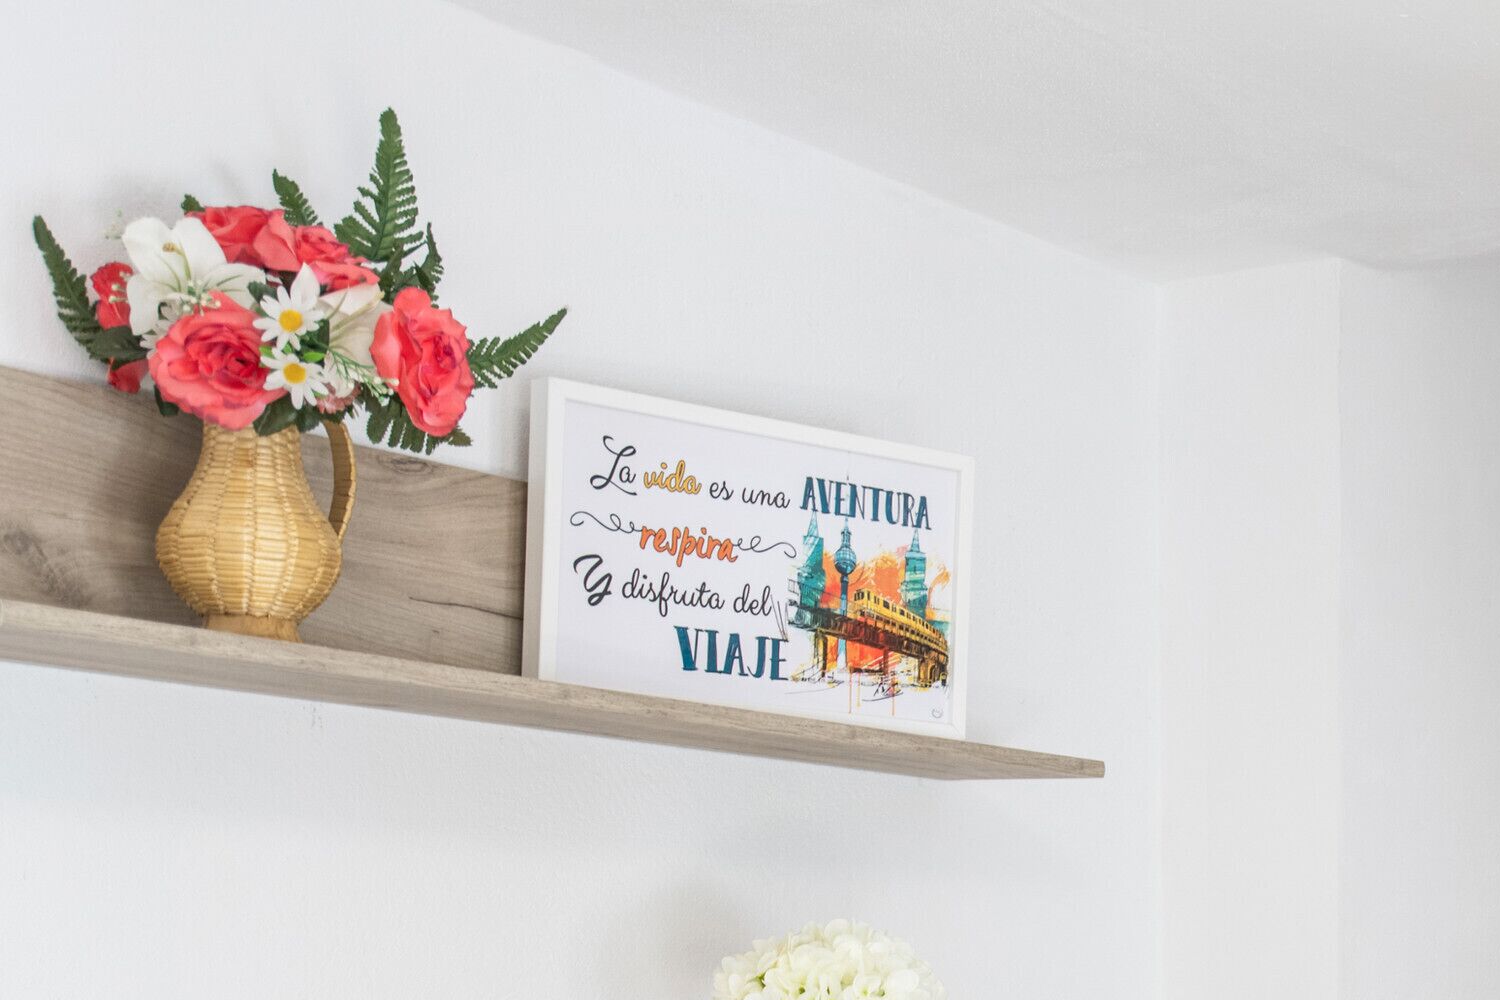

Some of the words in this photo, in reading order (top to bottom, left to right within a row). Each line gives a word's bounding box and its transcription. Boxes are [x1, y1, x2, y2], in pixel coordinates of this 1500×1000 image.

[590, 435, 637, 496] La
[643, 460, 702, 494] vida
[709, 481, 734, 501] es
[742, 486, 791, 509] una
[800, 476, 932, 530] AVENTURA
[640, 524, 738, 567] respira
[573, 554, 612, 606] Y
[621, 568, 725, 617] disfruta
[733, 585, 772, 617] del
[673, 626, 789, 681] VIAJE
